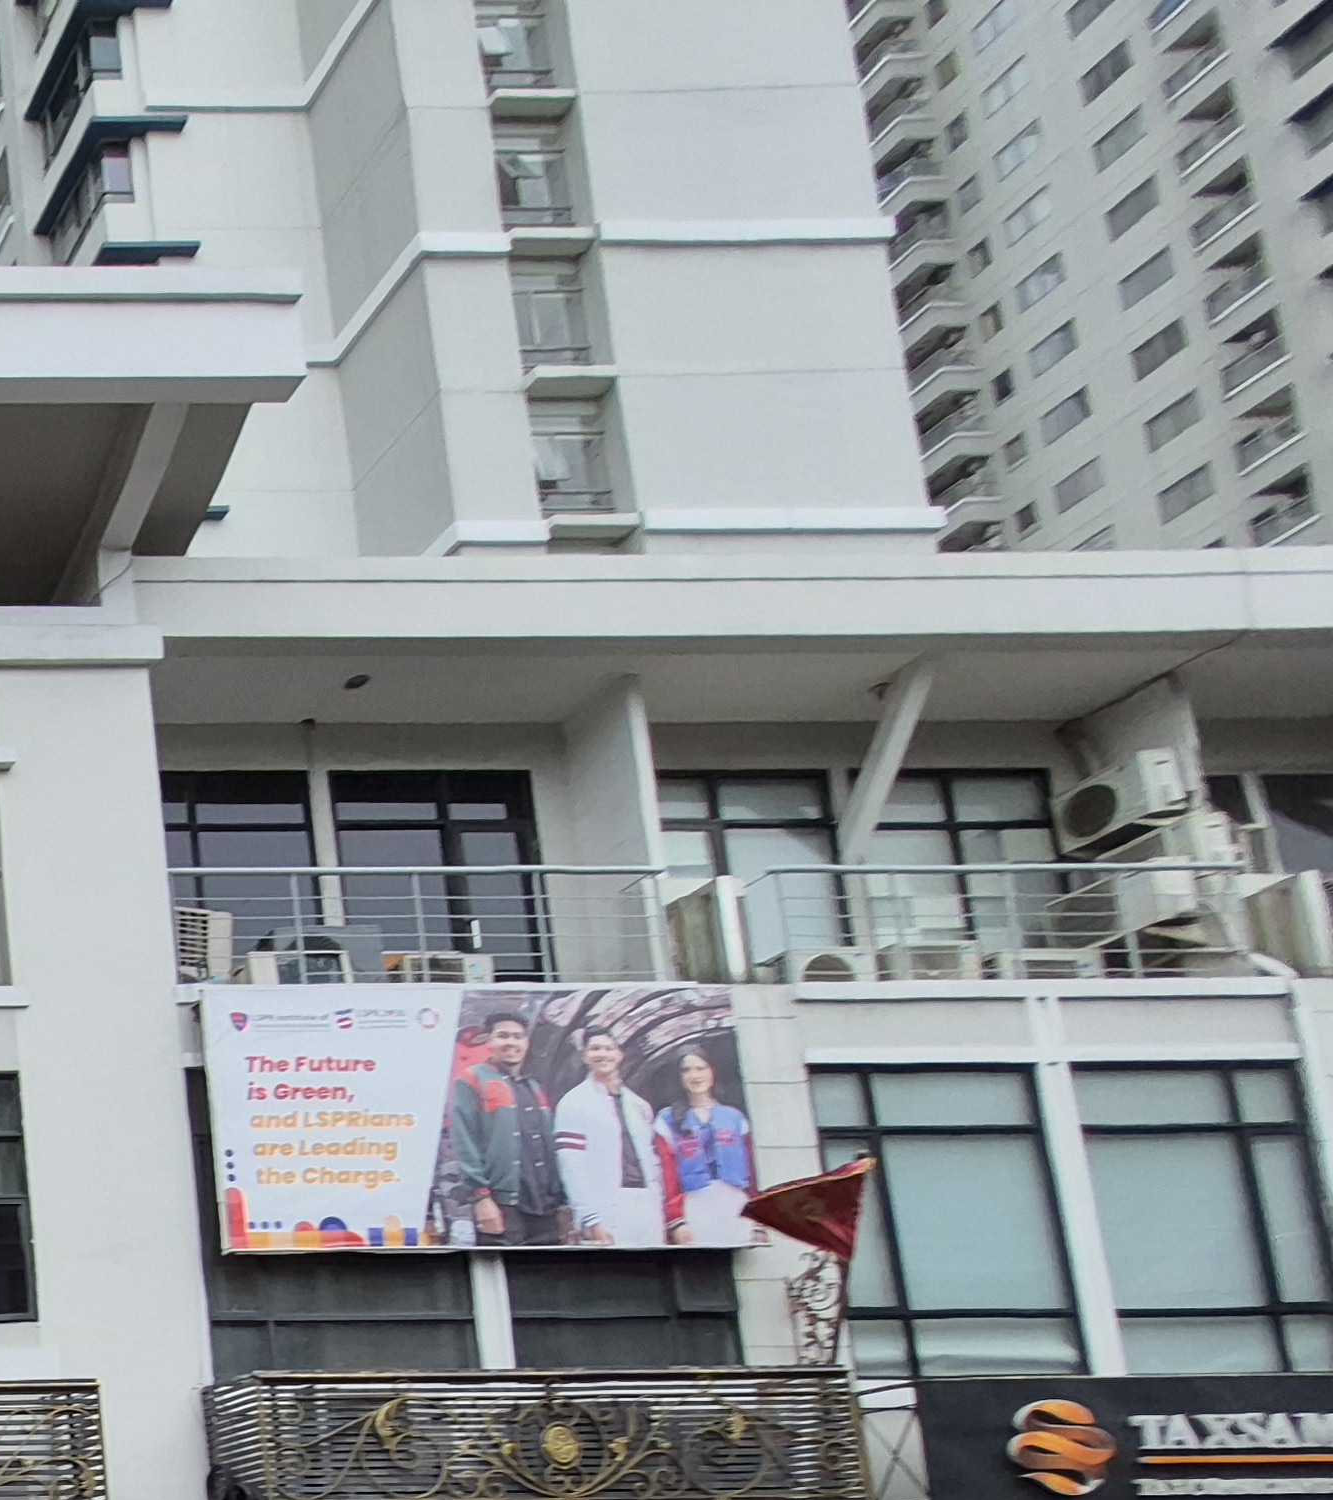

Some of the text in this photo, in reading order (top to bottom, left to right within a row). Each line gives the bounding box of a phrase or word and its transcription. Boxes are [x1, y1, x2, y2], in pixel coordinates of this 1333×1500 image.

[245, 1056, 376, 1072] The Future
[247, 1082, 355, 1103] is Green,
[251, 1109, 415, 1129] and LSPRians
[253, 1137, 398, 1161] are Leading
[256, 1167, 401, 1189] the Charge.
